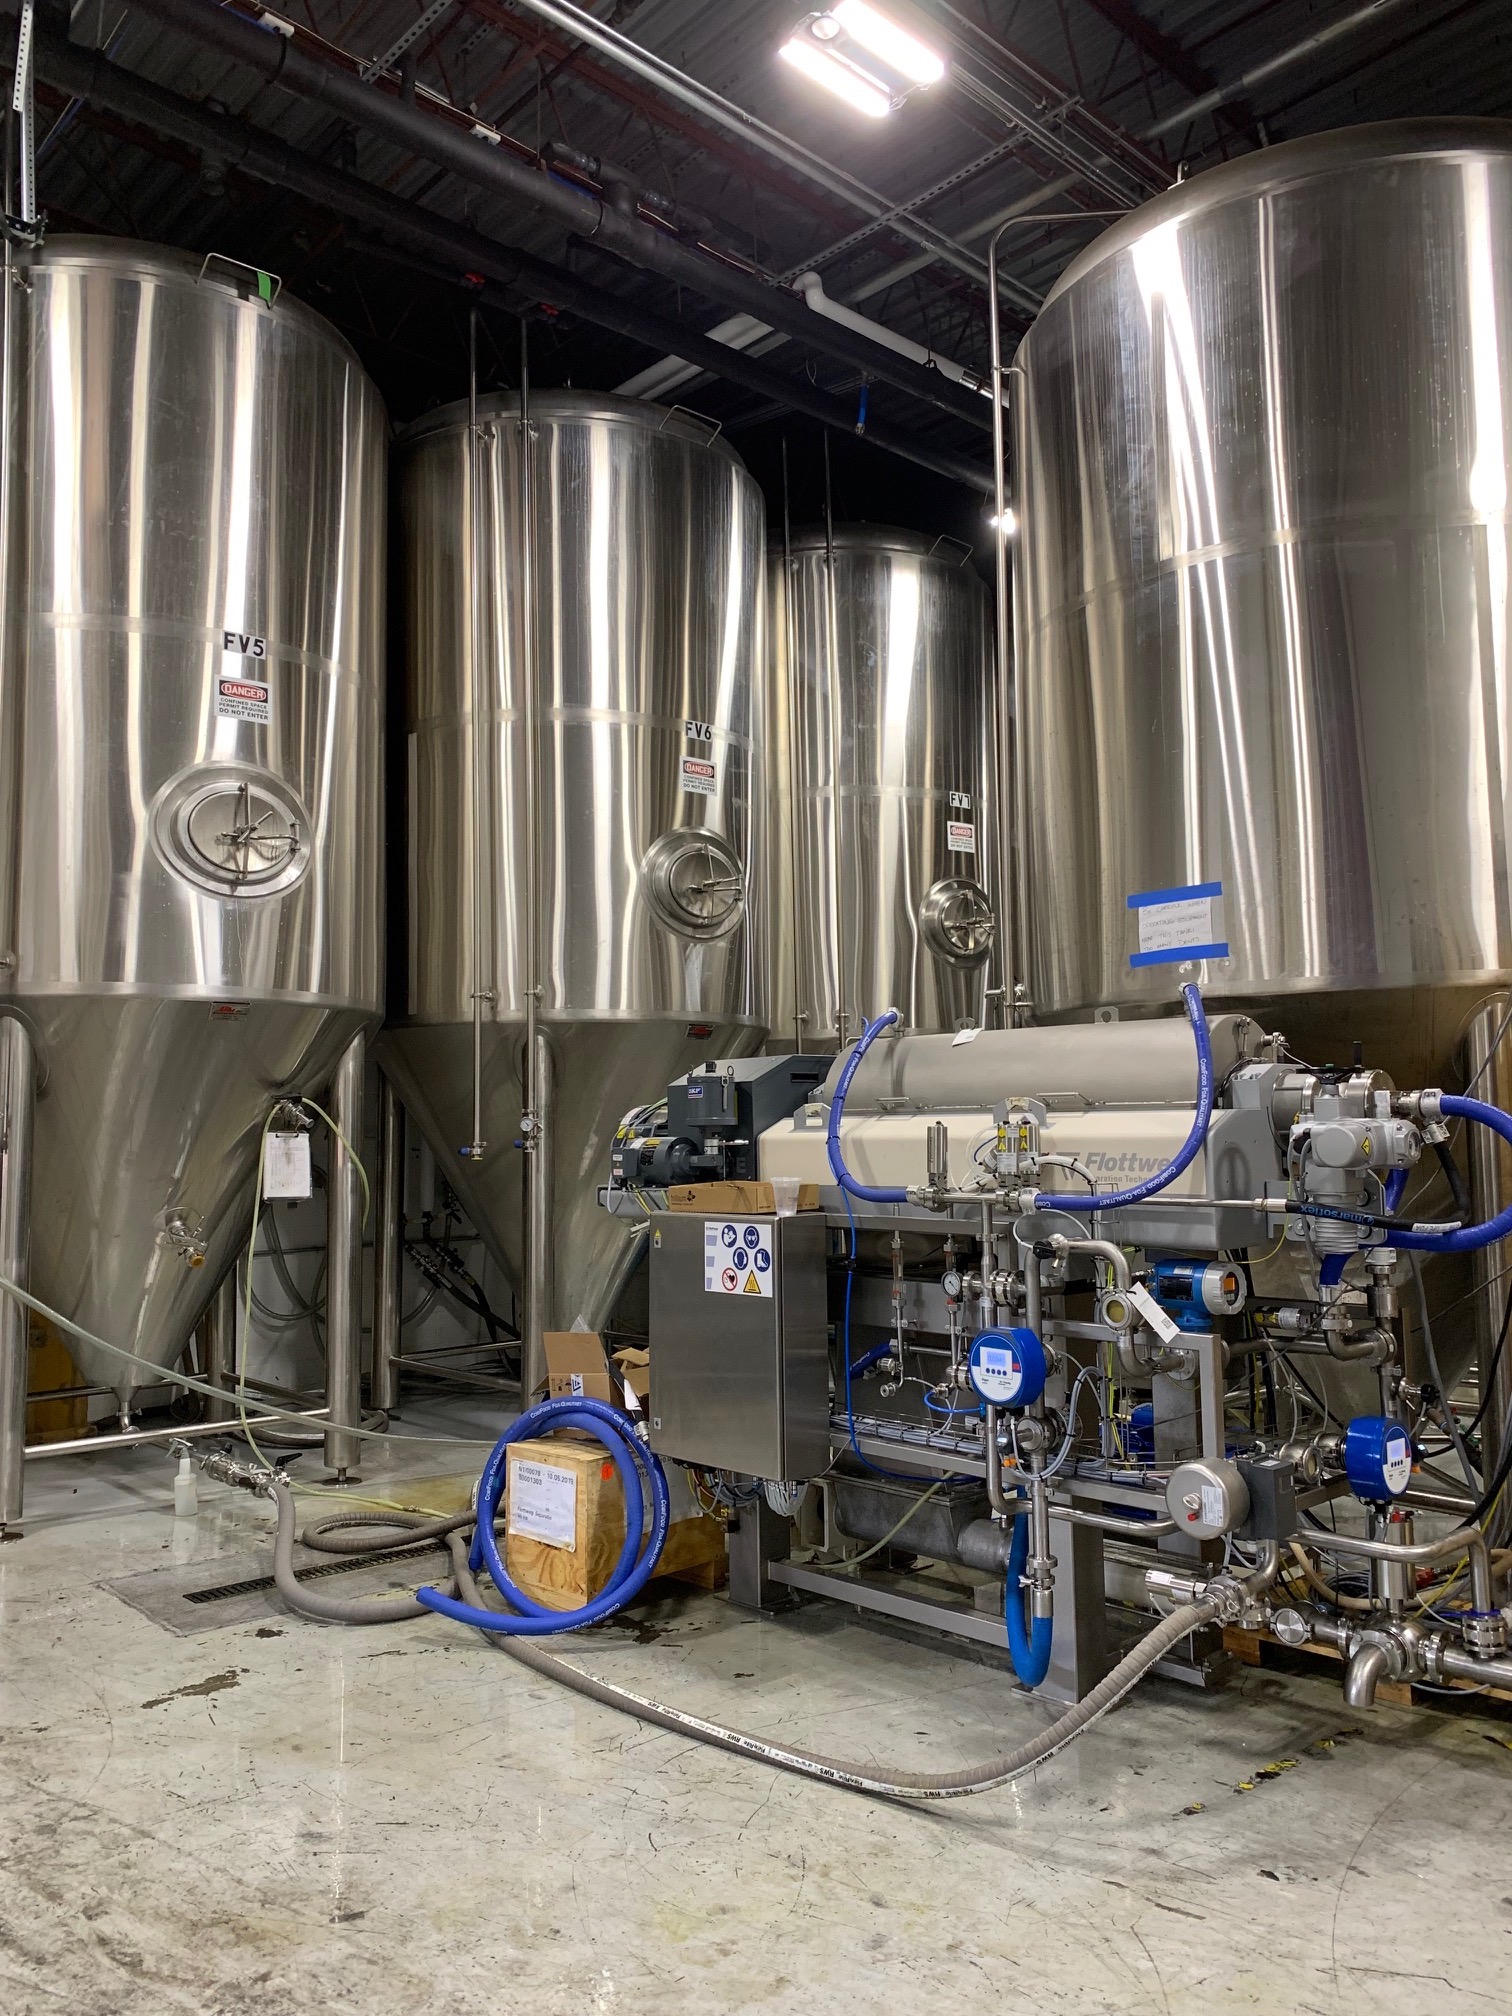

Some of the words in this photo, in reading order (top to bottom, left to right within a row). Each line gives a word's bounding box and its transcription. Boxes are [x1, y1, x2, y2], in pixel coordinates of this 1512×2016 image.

[224, 632, 264, 657] FV5
[224, 684, 264, 699] DANGER
[219, 702, 240, 710] PERMIT
[241, 705, 269, 715] REQUIRED
[221, 697, 248, 706] CONFINED
[250, 702, 267, 710] SPACE
[247, 712, 269, 720] ENTER
[685, 721, 712, 740] FV6
[686, 764, 712, 775] DANGER
[951, 793, 970, 808] FV7
[1157, 902, 1182, 913] CAREFUL
[1187, 899, 1207, 908] WHEN
[1142, 918, 1175, 929] OPERATING
[1177, 914, 1208, 924] EQUIPMENT
[1157, 941, 1172, 949] MANY
[688, 1087, 702, 1095] SKF
[1085, 1152, 1171, 1173] Flottwe
[1300, 1204, 1362, 1225] marsoflex
[726, 1733, 741, 1744] RWS
[819, 1767, 835, 1778] RWS
[924, 1790, 941, 1798] RWS
